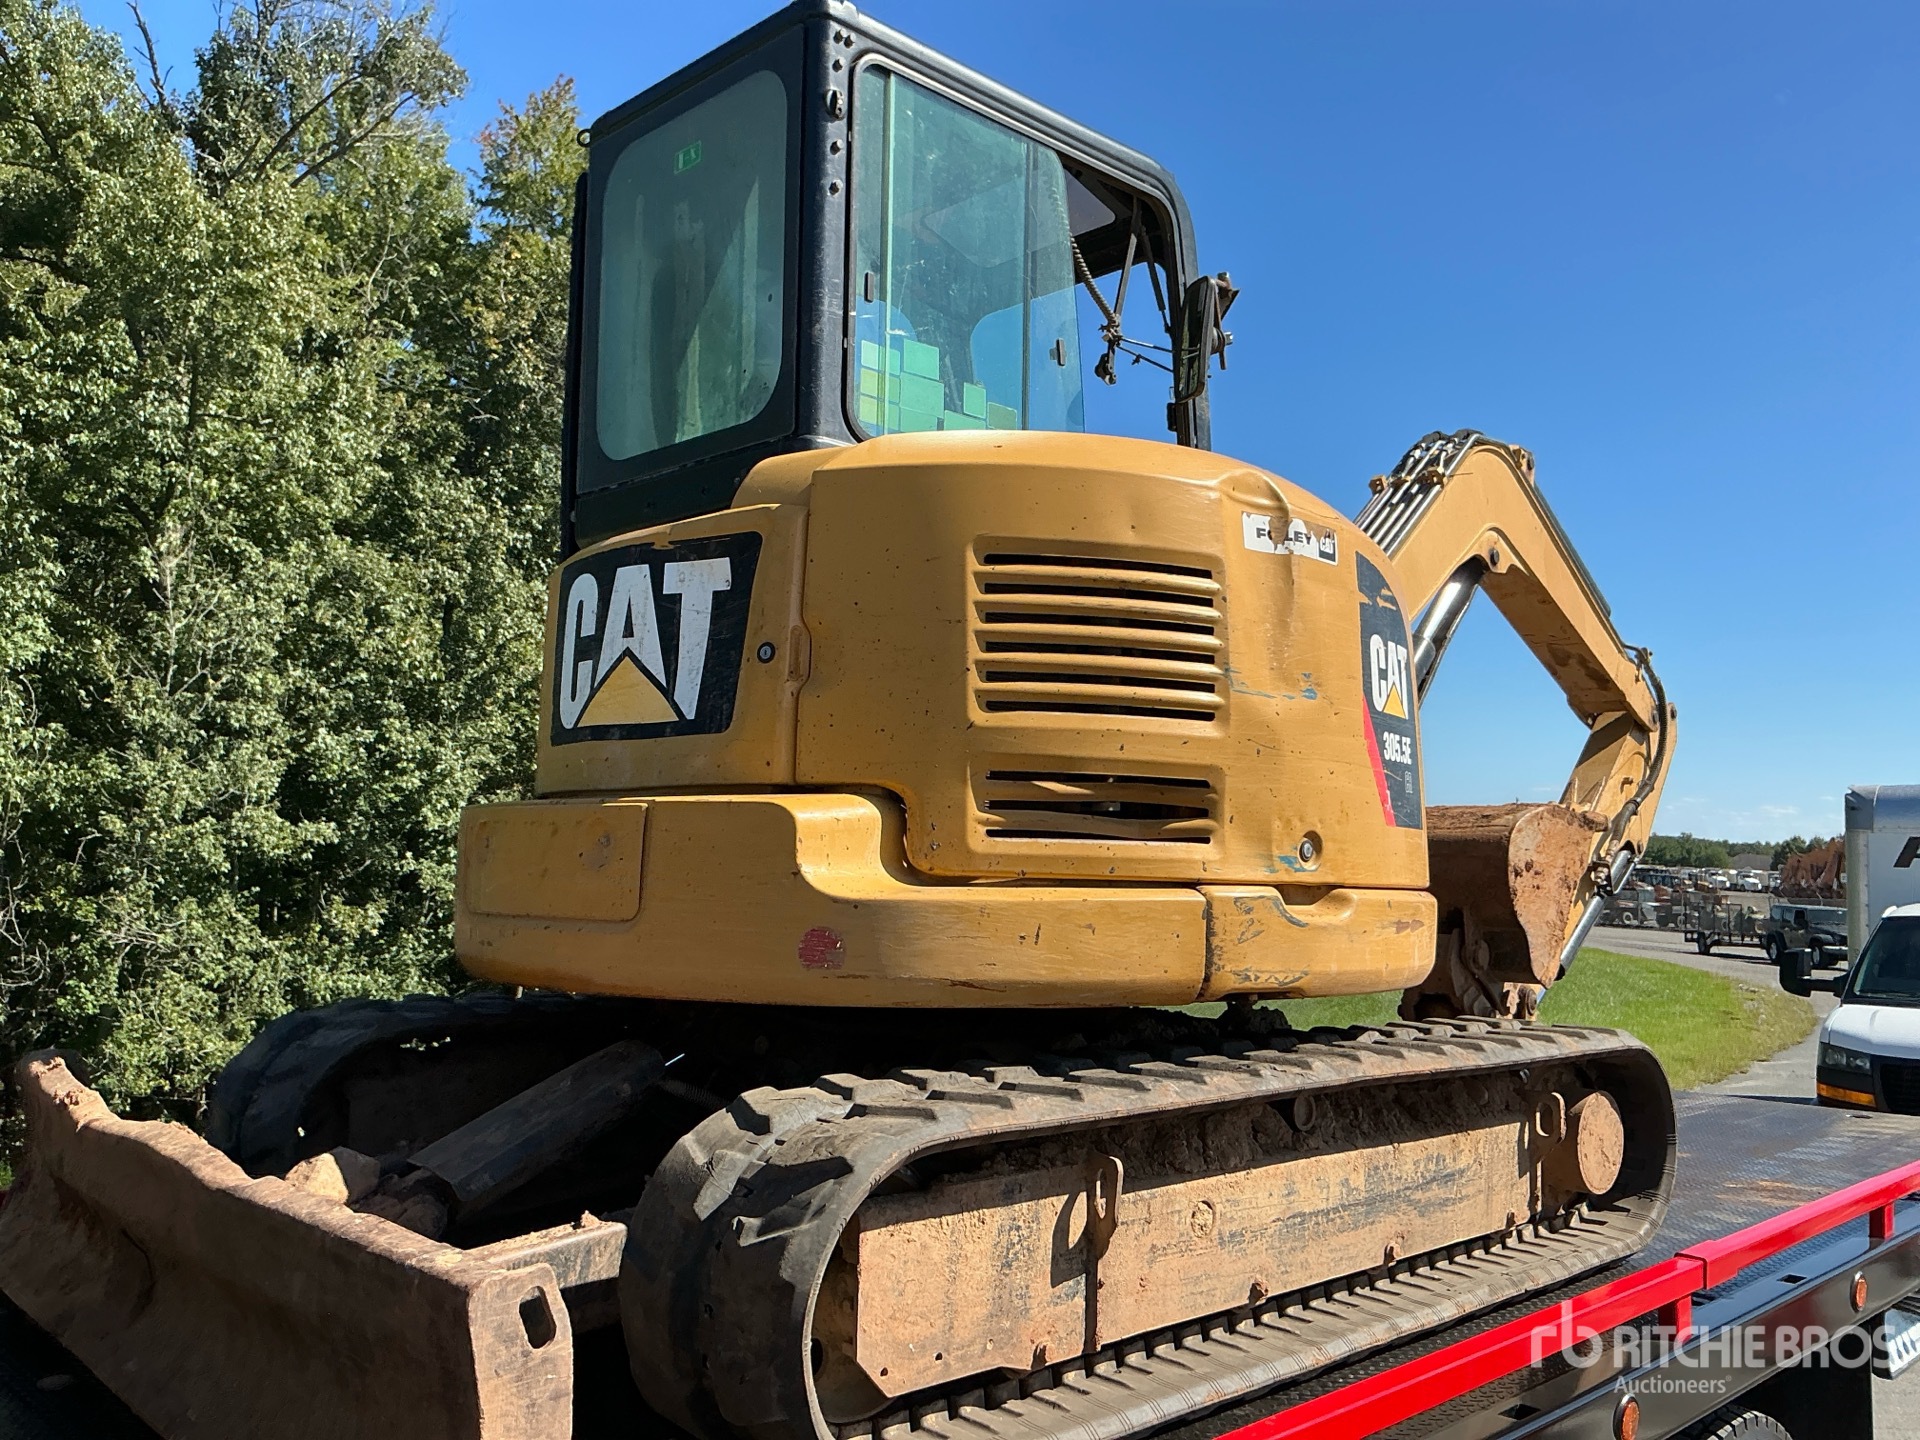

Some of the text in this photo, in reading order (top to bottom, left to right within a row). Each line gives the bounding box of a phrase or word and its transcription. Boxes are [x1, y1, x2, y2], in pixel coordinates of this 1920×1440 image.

[560, 557, 732, 730] CAT
[1369, 633, 1409, 720] CAT
[1383, 731, 1412, 765] 305.5E
